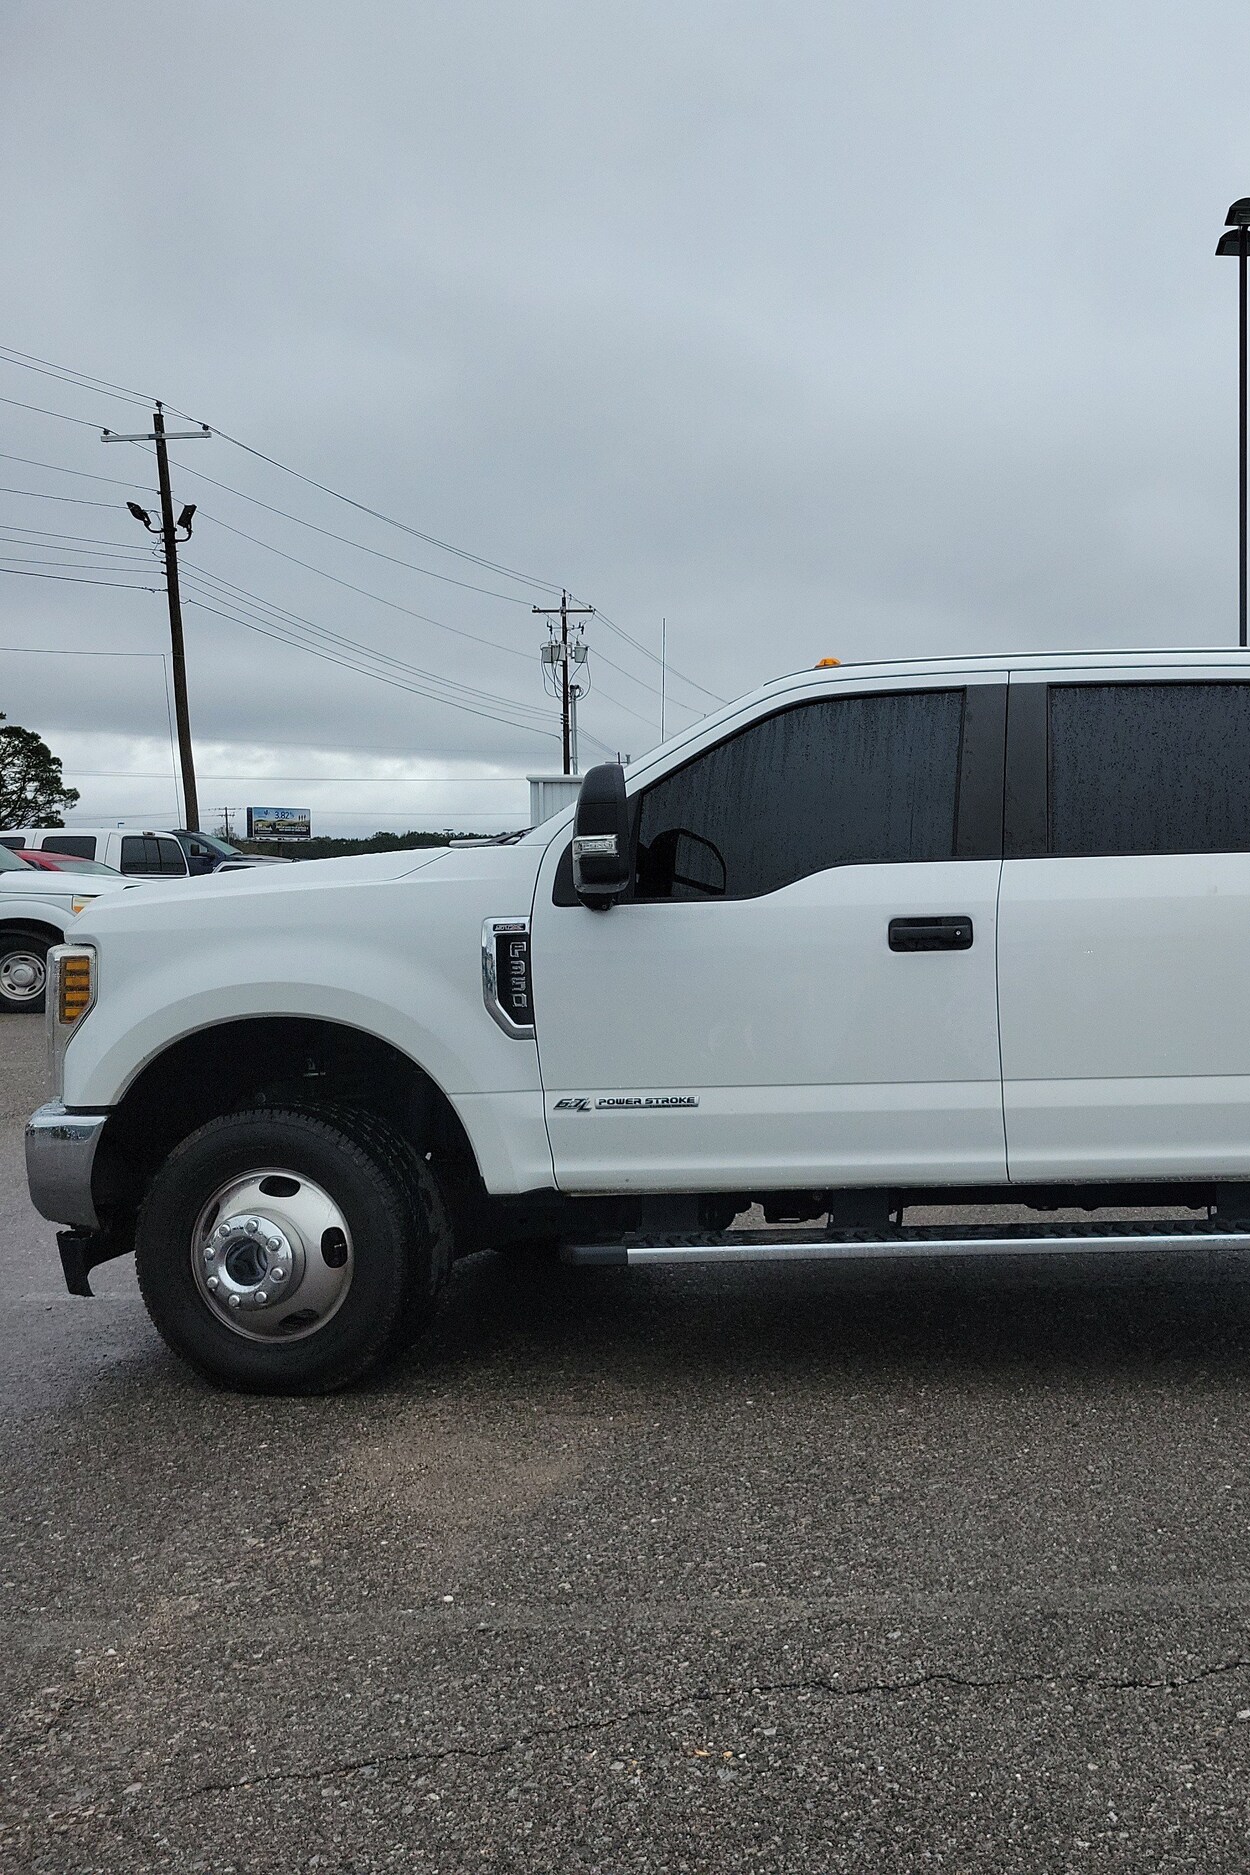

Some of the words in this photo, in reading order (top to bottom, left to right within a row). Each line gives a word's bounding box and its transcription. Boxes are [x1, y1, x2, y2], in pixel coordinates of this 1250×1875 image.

[509, 941, 528, 1008] F350
[598, 1098, 642, 1106] POWER
[645, 1097, 696, 1105] STROKE
